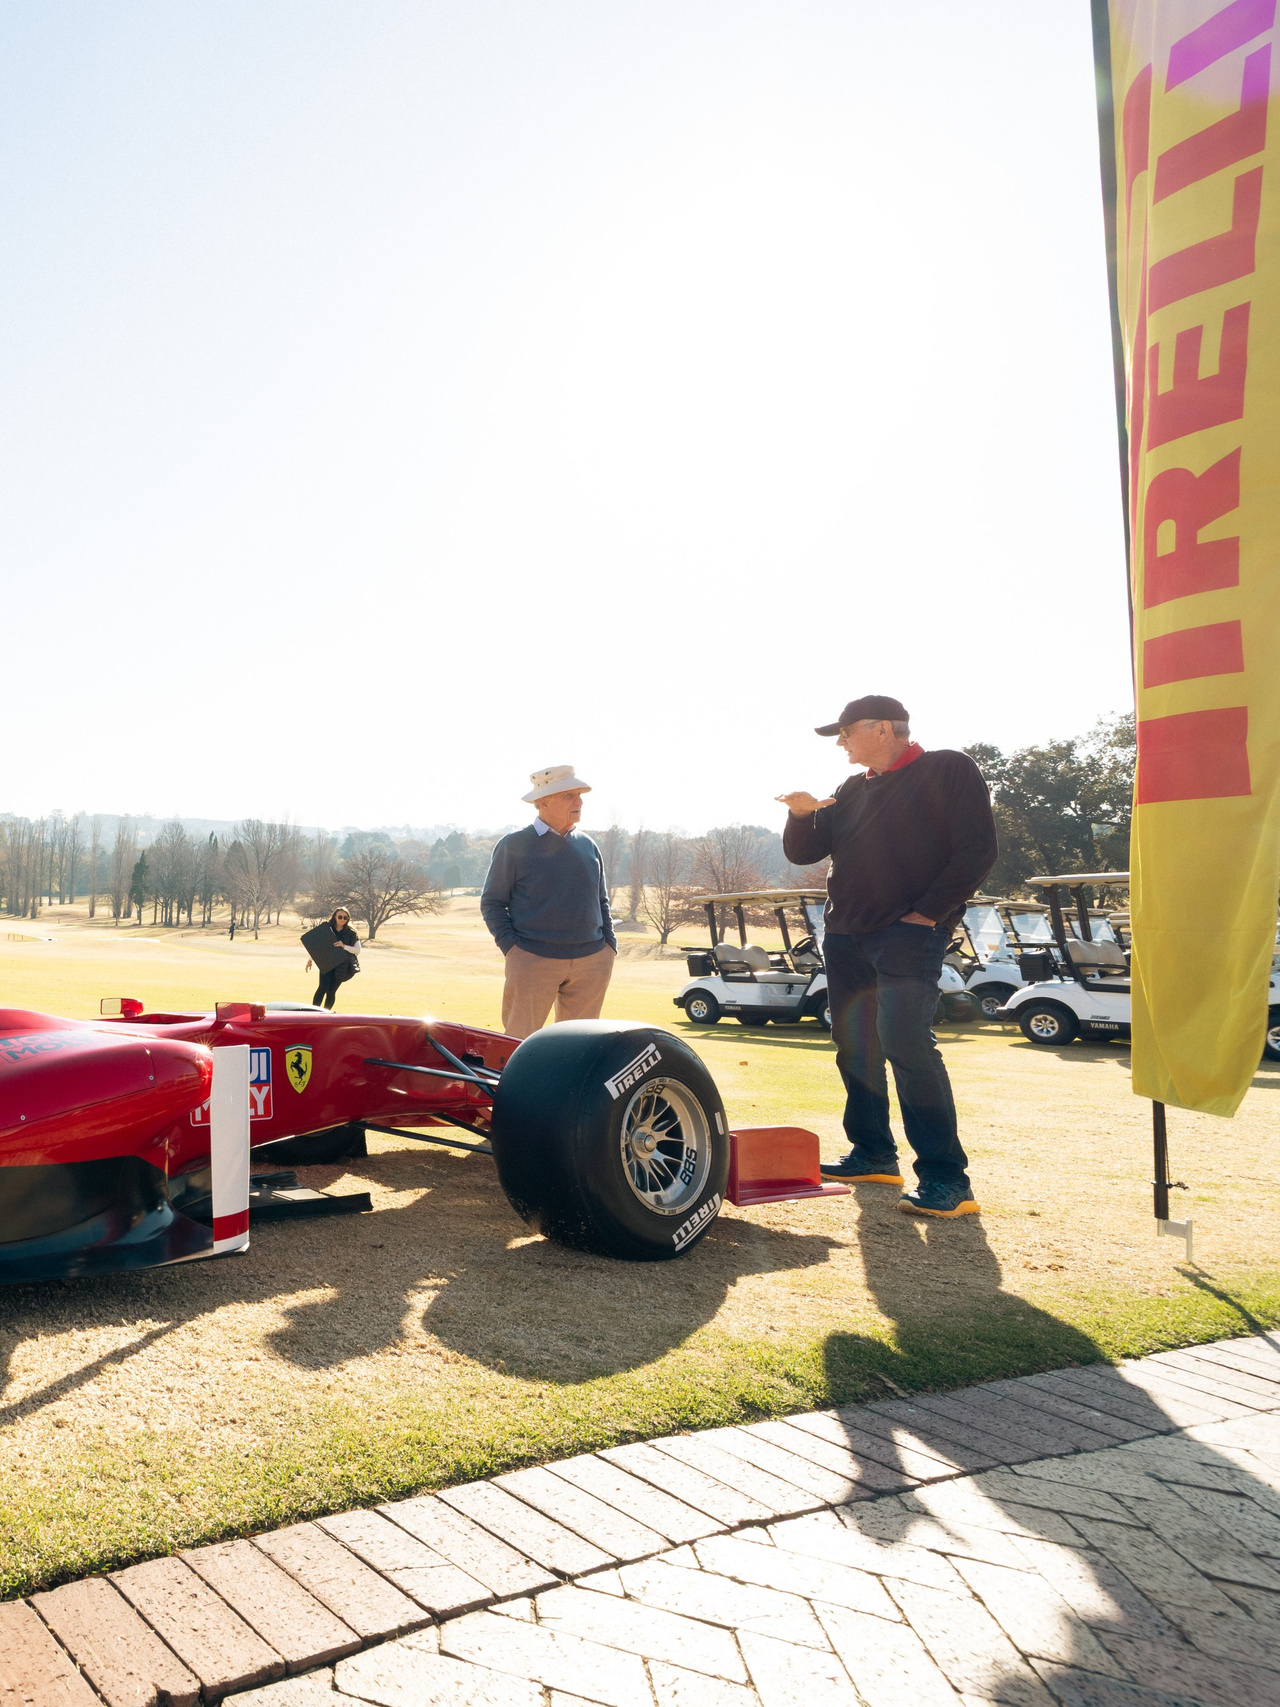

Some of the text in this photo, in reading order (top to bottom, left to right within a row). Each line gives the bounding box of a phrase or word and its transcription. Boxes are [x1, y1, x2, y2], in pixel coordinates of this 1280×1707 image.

[1090, 1022, 1119, 1030] YAMAHA
[604, 1043, 662, 1100] PIRELLI
[679, 1147, 698, 1187] BBS
[671, 1192, 721, 1252] PIRELLI
